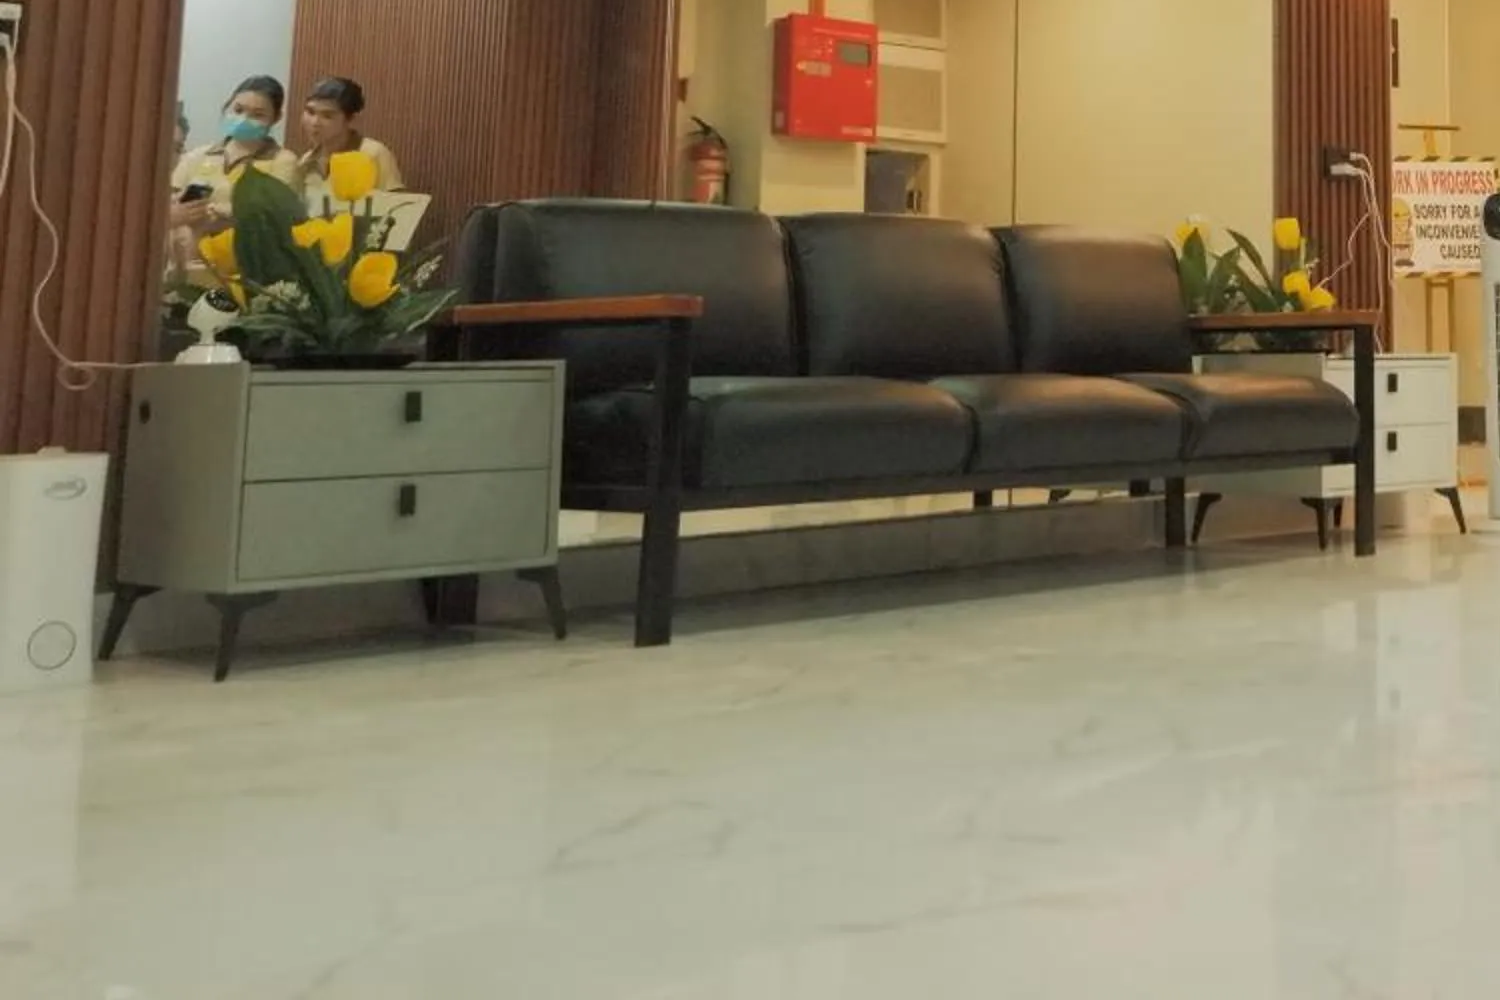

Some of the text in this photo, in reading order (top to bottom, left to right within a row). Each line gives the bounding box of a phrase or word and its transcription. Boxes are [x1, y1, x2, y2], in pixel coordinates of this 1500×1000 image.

[1415, 169, 1429, 195] IN
[1413, 204, 1447, 219] SORRY
[1451, 204, 1470, 219] FOR
